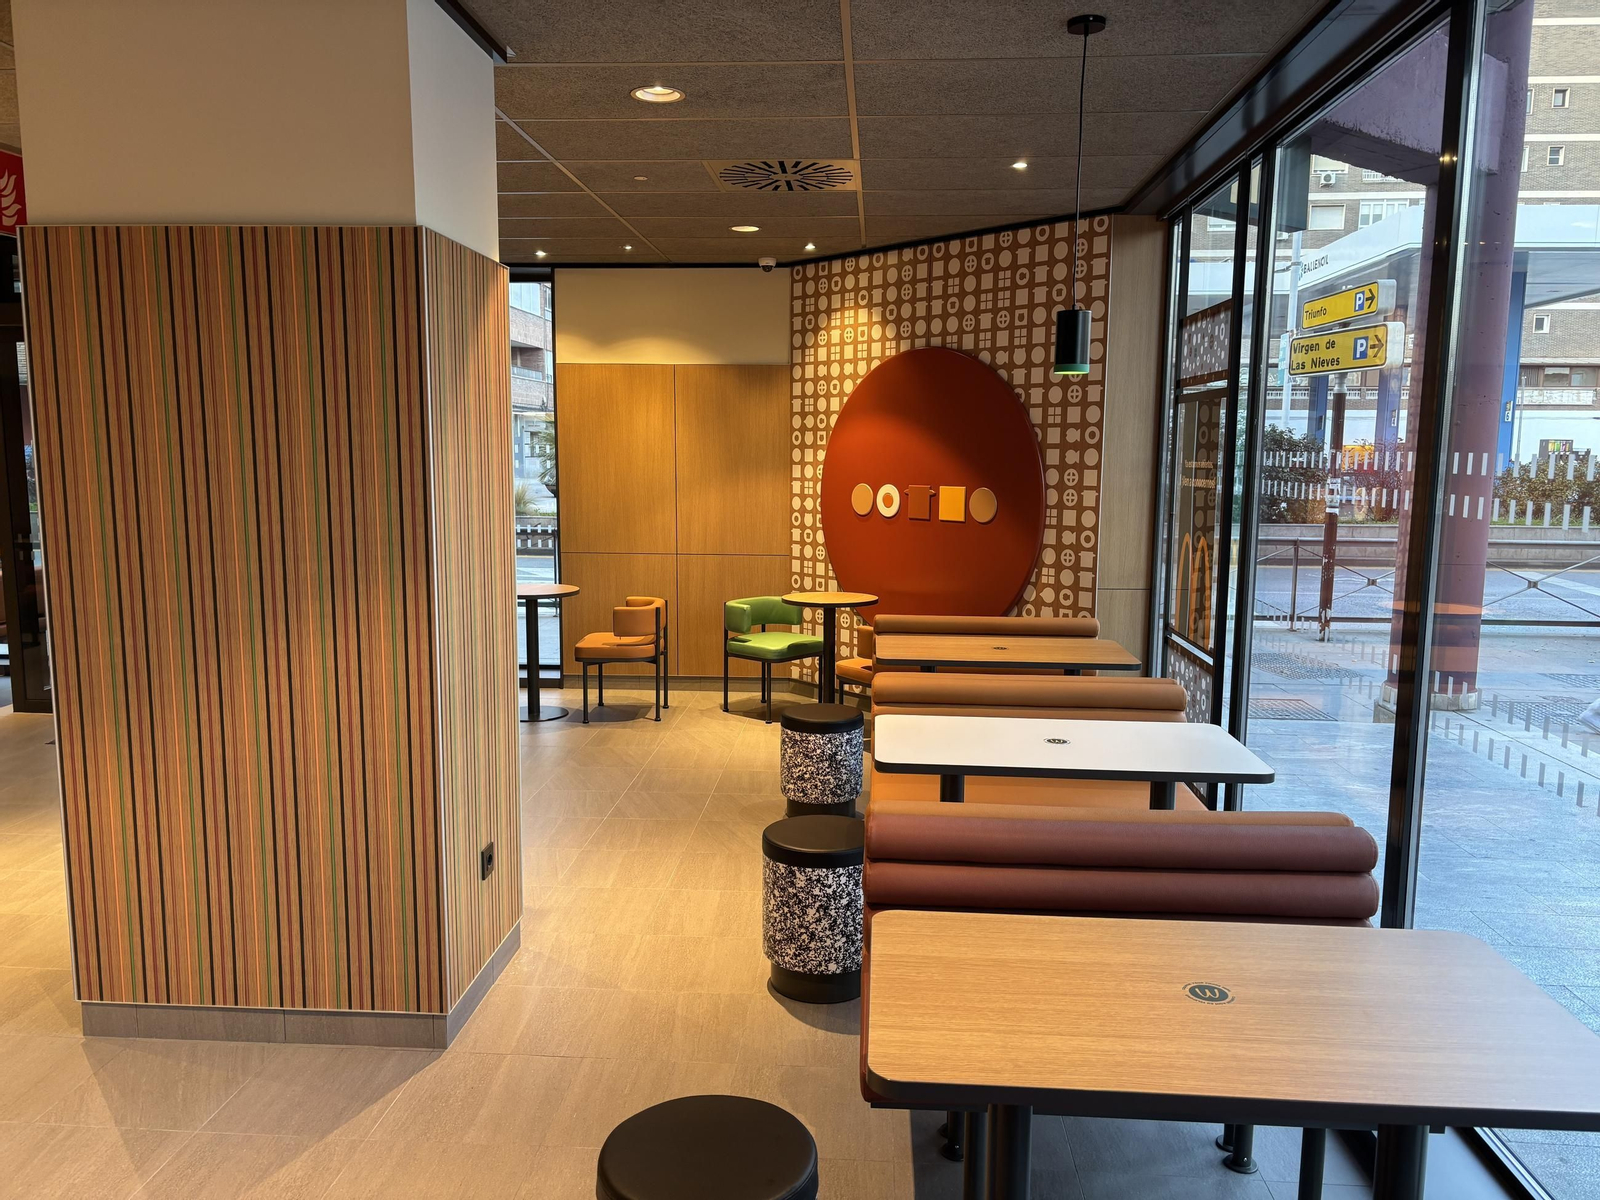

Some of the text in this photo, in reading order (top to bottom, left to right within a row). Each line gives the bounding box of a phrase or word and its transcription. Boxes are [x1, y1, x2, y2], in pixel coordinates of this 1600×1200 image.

[1304, 306, 1327, 320] Triunfo
[1293, 339, 1336, 354] Virgen de
[1291, 357, 1340, 371] Las Nieves
